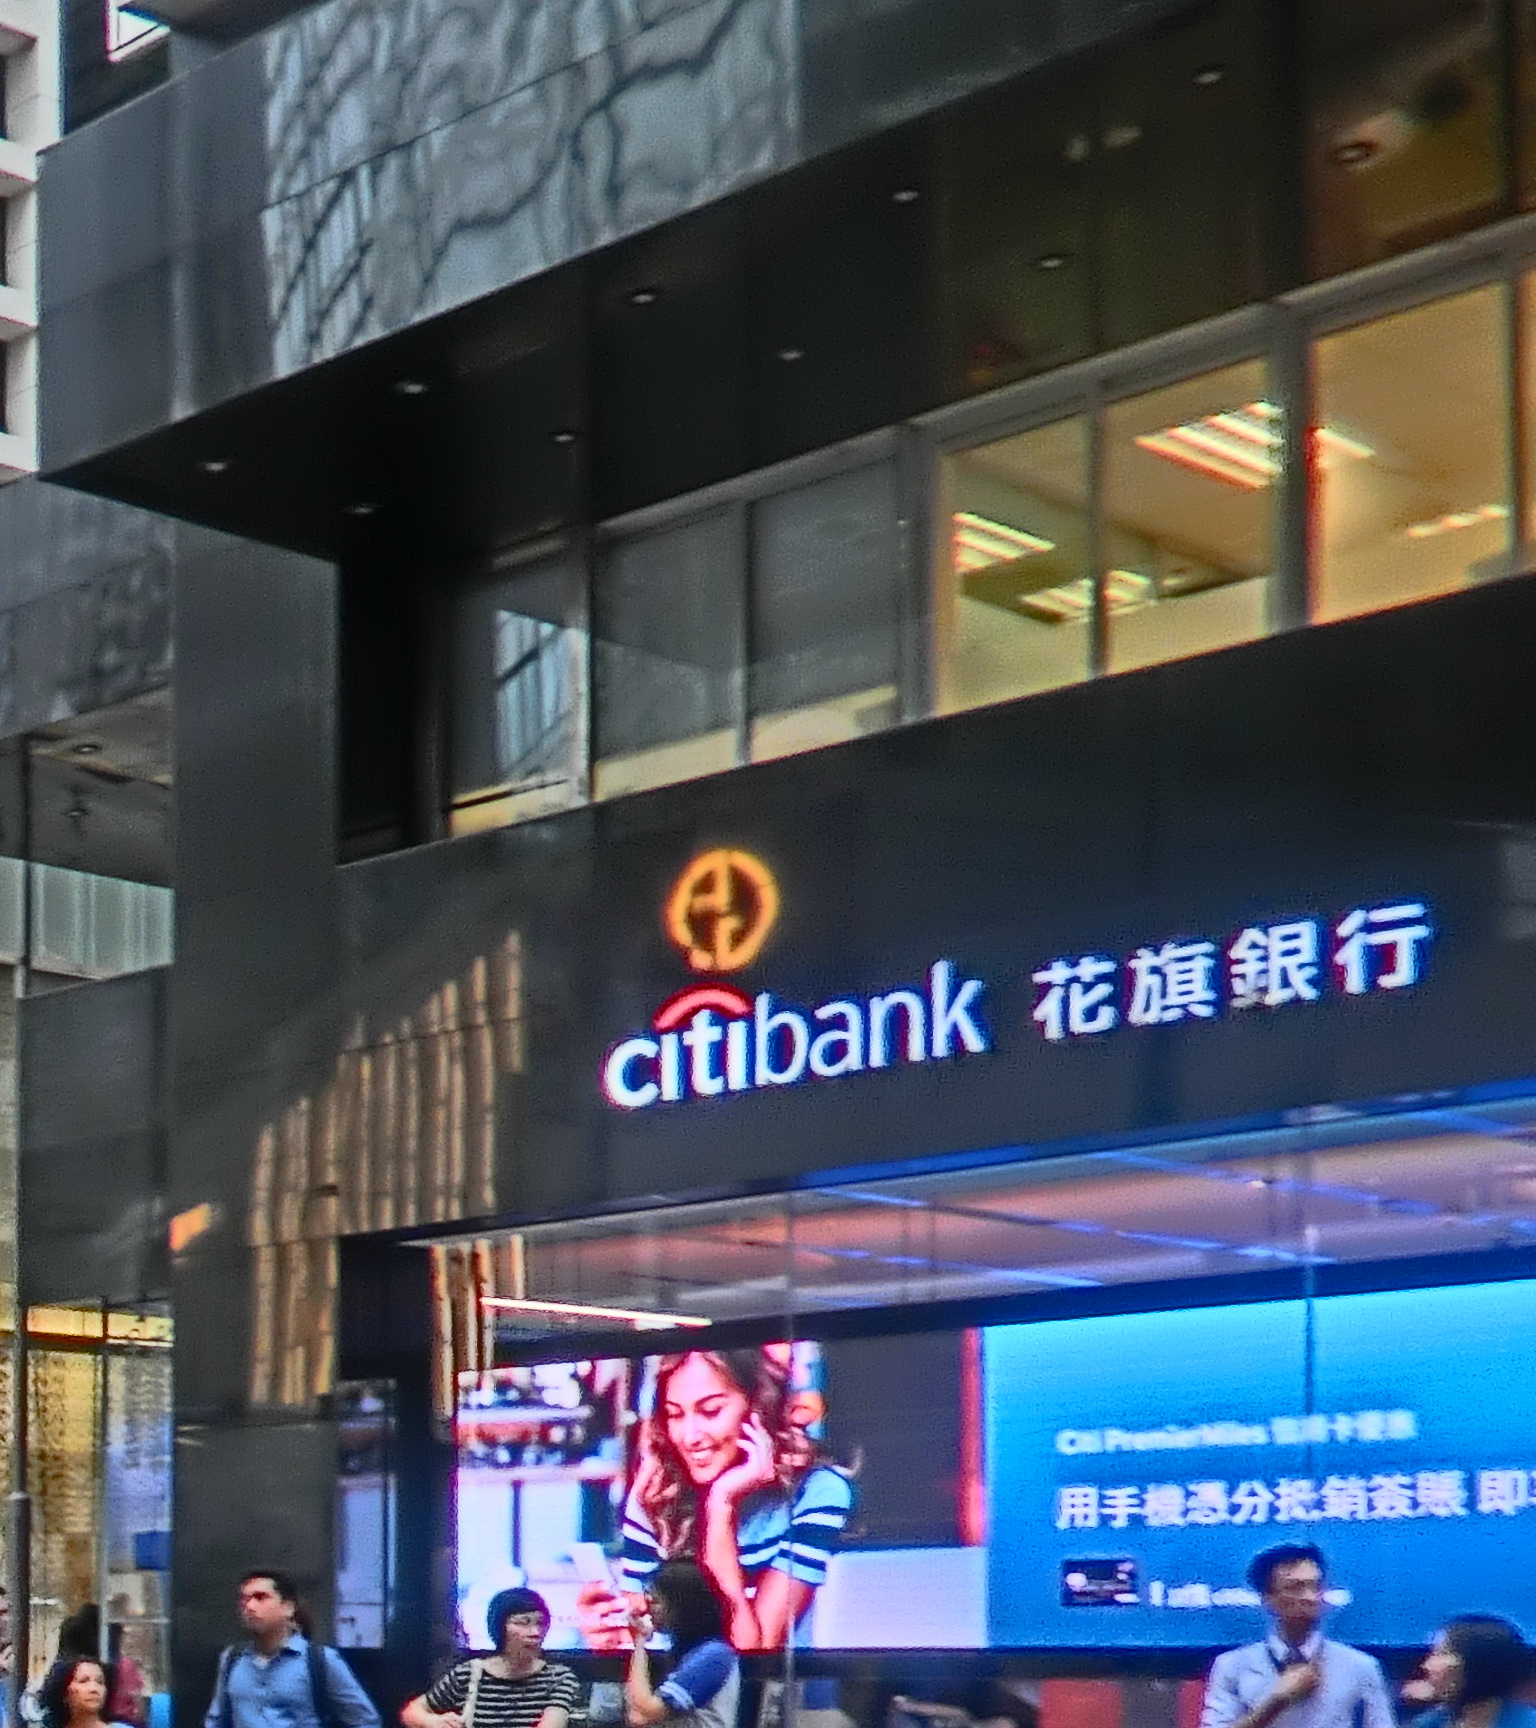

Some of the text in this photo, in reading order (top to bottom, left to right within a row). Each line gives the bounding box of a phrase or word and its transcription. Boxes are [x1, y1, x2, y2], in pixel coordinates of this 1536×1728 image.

[603, 901, 1433, 1110] citibank 花旗銀行
[1475, 1469, 1536, 1516] 即
